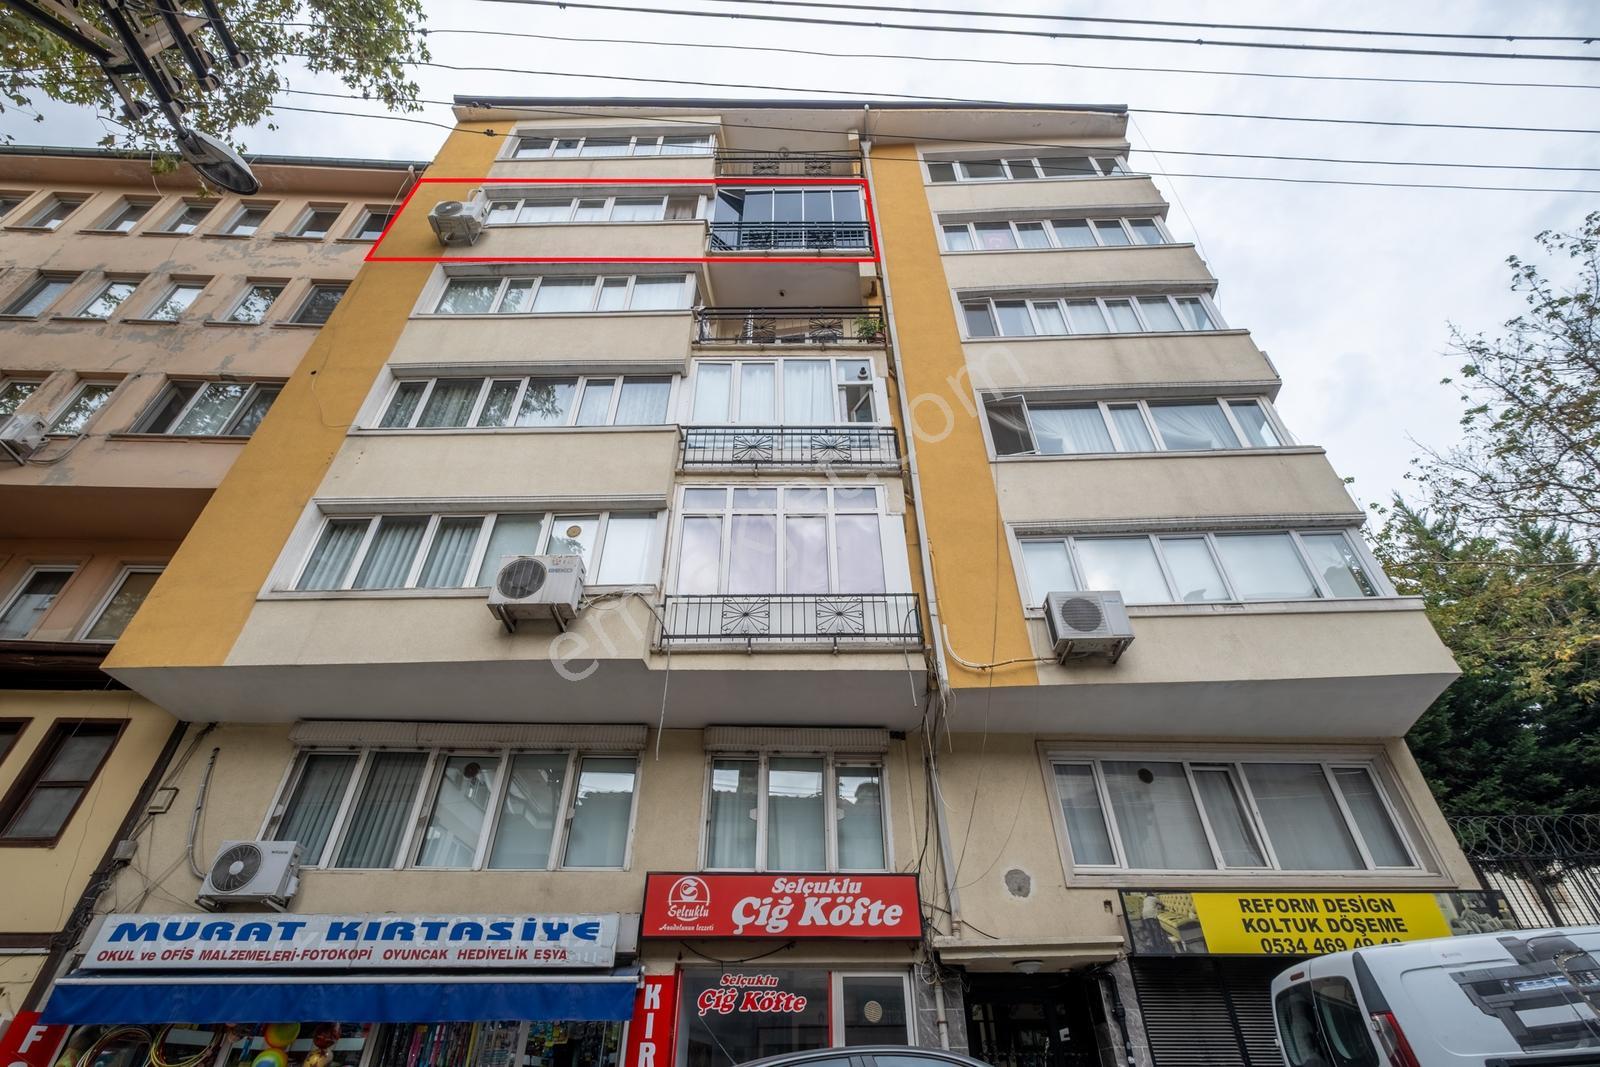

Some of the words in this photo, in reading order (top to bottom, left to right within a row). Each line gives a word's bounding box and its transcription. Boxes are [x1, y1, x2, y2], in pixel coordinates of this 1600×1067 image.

[771, 877, 863, 898] Selçuklu
[731, 896, 795, 935] Çiğ
[798, 896, 904, 927] Köfte
[1238, 897, 1321, 913] REFORM
[107, 921, 307, 942] MURAT
[325, 917, 601, 942] KIRTASİYE
[1241, 917, 1321, 933] KOLTUK
[1328, 914, 1409, 936] DÖŞEME
[96, 949, 135, 962] OKUL
[140, 951, 157, 962] ve
[160, 946, 195, 961] OFİS
[382, 948, 449, 961] OYUNCAK
[457, 945, 528, 961] HEDİYELİK
[534, 948, 568, 963] EŞYA
[1260, 937, 1308, 954] 0534
[1313, 937, 1348, 953] 469
[720, 973, 779, 988] Selçuklu
[697, 987, 739, 1017] Çiğ
[739, 989, 808, 1014] Köfte
